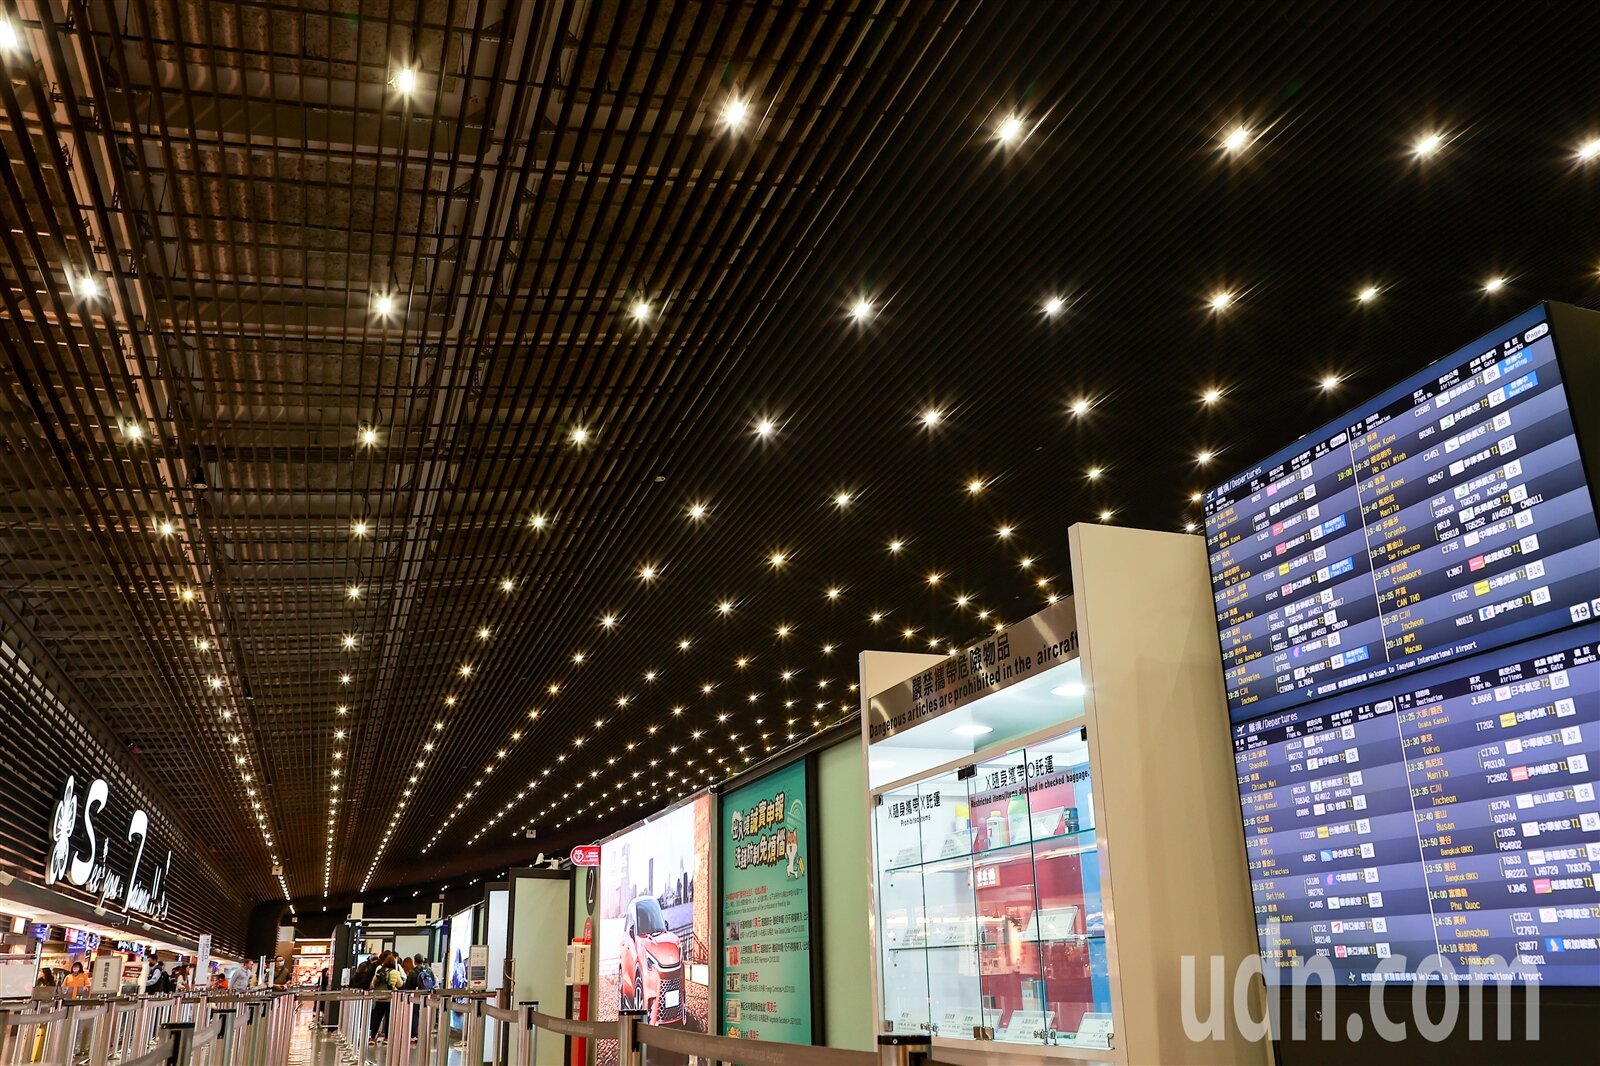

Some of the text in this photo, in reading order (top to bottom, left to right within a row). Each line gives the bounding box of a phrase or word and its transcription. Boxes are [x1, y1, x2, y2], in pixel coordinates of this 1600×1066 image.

[1351, 368, 1496, 451] 19:30 T1 B6
[1355, 392, 1502, 471] 19:30 T2 C2
[1359, 480, 1373, 493] 19:40
[1485, 421, 1493, 432] T1
[1497, 416, 1507, 428] B5
[1371, 451, 1406, 474] Ho Chi Minh
[1338, 468, 1351, 480] 19:00
[1363, 440, 1514, 514] 19:40 T1 B1R
[1366, 464, 1518, 536] 19:40 T2 C6
[1380, 503, 1399, 517] Manila
[1370, 489, 1524, 558] 19:50 BR18 T2 C3
[1384, 524, 1406, 539] Toronto
[1374, 568, 1389, 580] 19:55
[1506, 518, 1514, 528] T1
[1518, 513, 1529, 525] A9
[1387, 542, 1420, 561] San Francisco
[1378, 539, 1535, 602] 19:55 T1 B2
[1392, 568, 1421, 584] Singapore
[1382, 614, 1398, 625] 20:00
[1517, 568, 1526, 579] T1
[1529, 564, 1542, 576] B1R
[1397, 593, 1420, 607] CAN THO
[1386, 637, 1402, 648] 20:10
[1522, 594, 1531, 605] T1
[1535, 590, 1546, 601] B3
[1573, 606, 1589, 619] 19
[1401, 617, 1423, 630] Incheon
[1405, 643, 1421, 654] Macau
[1417, 648, 1454, 665] International
[1455, 641, 1477, 654] Airport
[912, 633, 1010, 701] 嚴禁攜帶危險物品
[870, 633, 1079, 739] Dangerous articles are prohibited in the aircraft
[1399, 712, 1415, 723] 13:25
[1540, 677, 1549, 688] T2
[1335, 728, 1352, 738] T1 B2
[1403, 737, 1419, 747] 13:30
[1476, 720, 1494, 731] IT202
[1546, 704, 1555, 715] T1
[1559, 703, 1570, 714] B3
[1338, 751, 1355, 762] T2 C5
[1407, 730, 1576, 771] 13:35 CI703 T1 A7
[1423, 744, 1440, 755] Tokyo
[1342, 776, 1349, 785] T2
[1412, 786, 1428, 796] 13:35
[1430, 784, 1442, 793] 仁川
[1558, 760, 1568, 771] T1
[1572, 759, 1582, 769] B1
[1427, 768, 1448, 780] Manila
[971, 796, 992, 808] Restricted
[1019, 784, 1038, 796] allowed
[1039, 783, 1044, 791] in
[1044, 777, 1065, 789] checked
[1432, 794, 1456, 806] Incheon
[1356, 798, 1363, 807] A1
[1416, 812, 1433, 822] 13:40
[1563, 788, 1574, 799] T2
[901, 817, 920, 827] Prohibited
[1436, 821, 1454, 831] Busan
[1421, 838, 1438, 847] 13:50
[1570, 818, 1580, 828] T1
[1353, 847, 1360, 855] T2
[1499, 840, 1522, 850] PG4902
[1425, 847, 1586, 873] 13:55 TG633 T1
[1534, 864, 1559, 876] LH9729
[1566, 862, 1591, 873] TK8375
[588, 870, 595, 904] 2
[1430, 876, 1594, 899] 14:00 VJ845 T1
[1361, 896, 1368, 904] T1
[1450, 901, 1480, 910] Phu Quoc
[1435, 907, 1600, 926] 14:05 CI521 T2
[1455, 928, 1489, 938] Guangzhou
[1369, 946, 1376, 954] T1
[1440, 944, 1457, 952] 14:10
[1441, 972, 1449, 981] to
[1474, 972, 1515, 980] International
[1518, 971, 1543, 980] Airport
